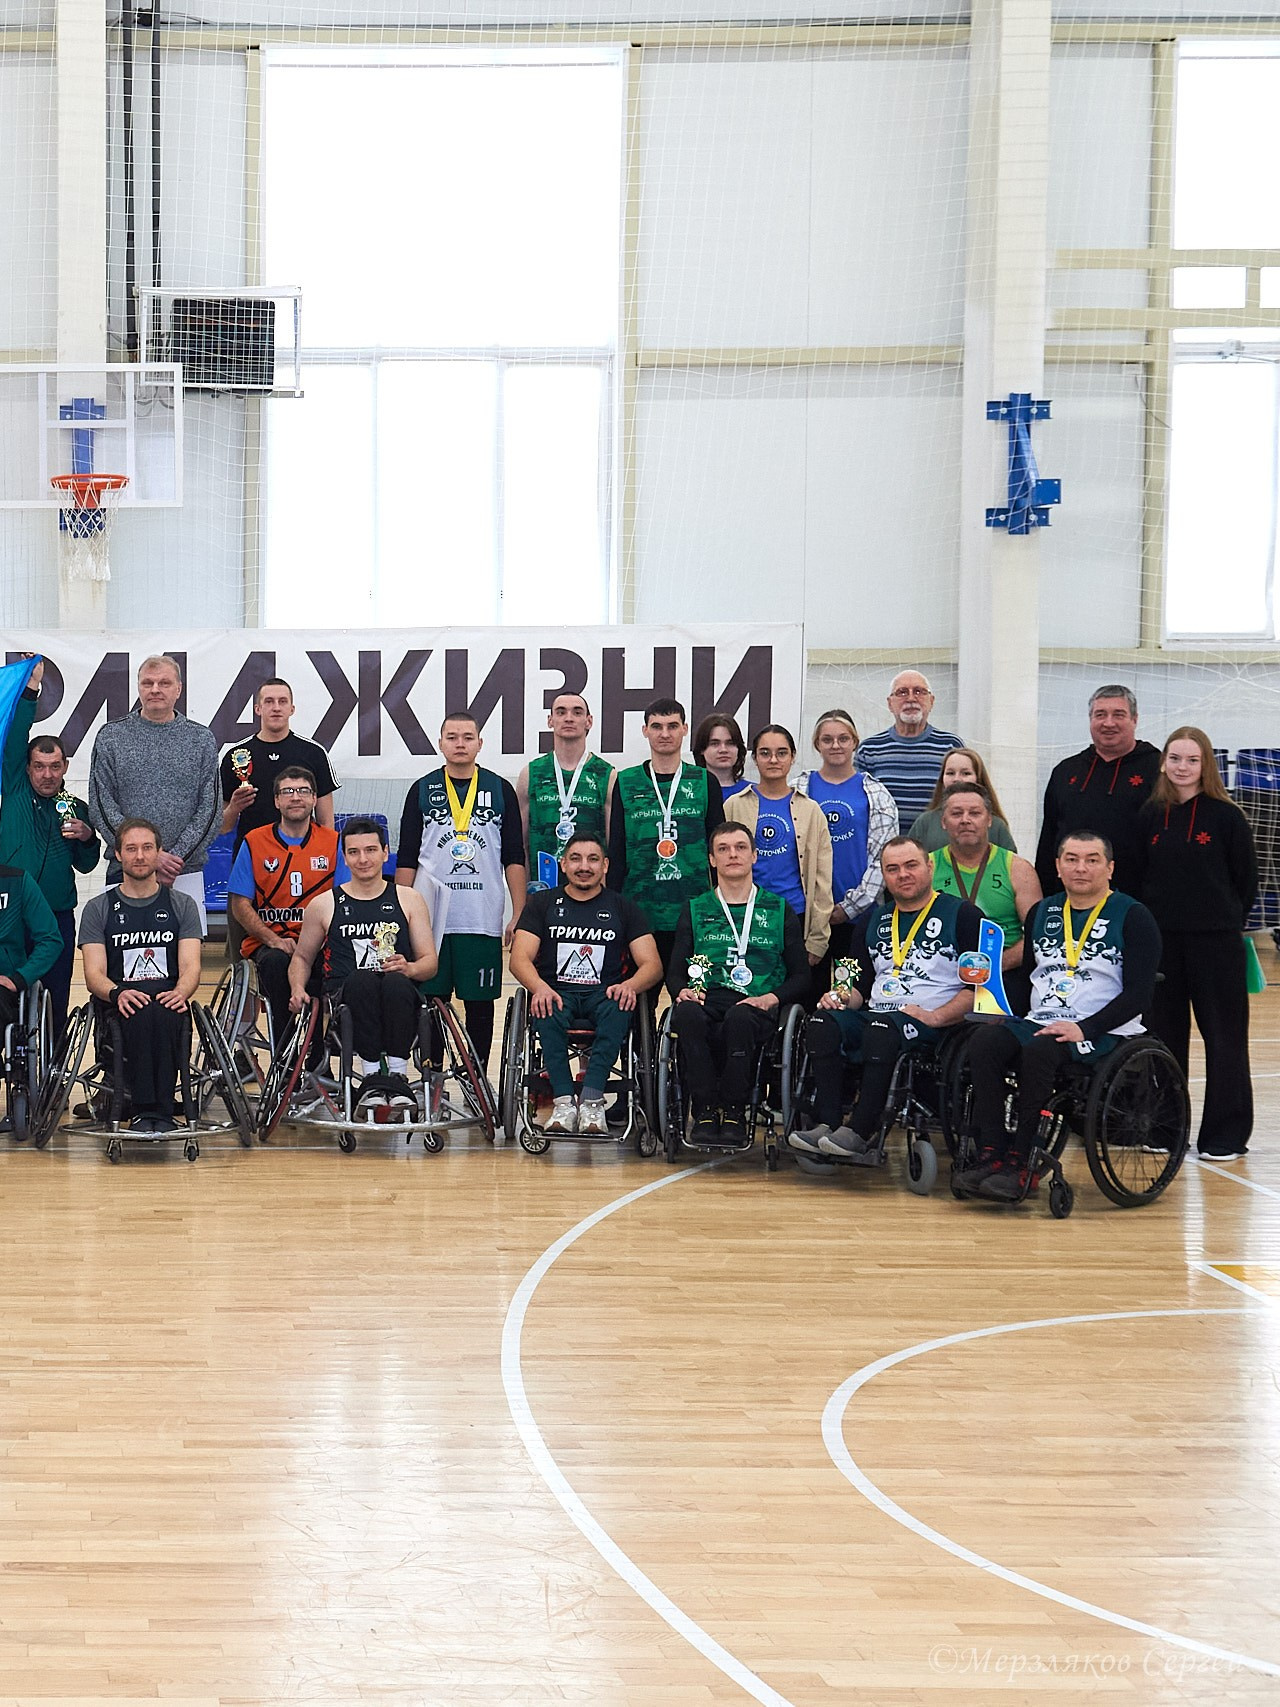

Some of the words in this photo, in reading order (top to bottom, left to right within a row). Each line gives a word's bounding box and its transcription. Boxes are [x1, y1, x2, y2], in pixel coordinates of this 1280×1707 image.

[308, 645, 774, 757] ЖИЗНИ
[477, 790, 492, 808] 11
[631, 809, 664, 819] «КРЫЛЬ
[827, 812, 840, 823] 10
[762, 827, 775, 838] 10
[289, 871, 303, 897] 8
[991, 873, 1003, 889] 5
[258, 907, 304, 923] ЛОКОМ
[549, 926, 616, 941] ТРИУМФ
[879, 926, 893, 934] RB
[925, 917, 943, 939] 9
[1090, 918, 1110, 939] 5
[111, 930, 174, 947] ТРИУМФ
[747, 936, 774, 945] АРСА»
[478, 967, 496, 988] 11
